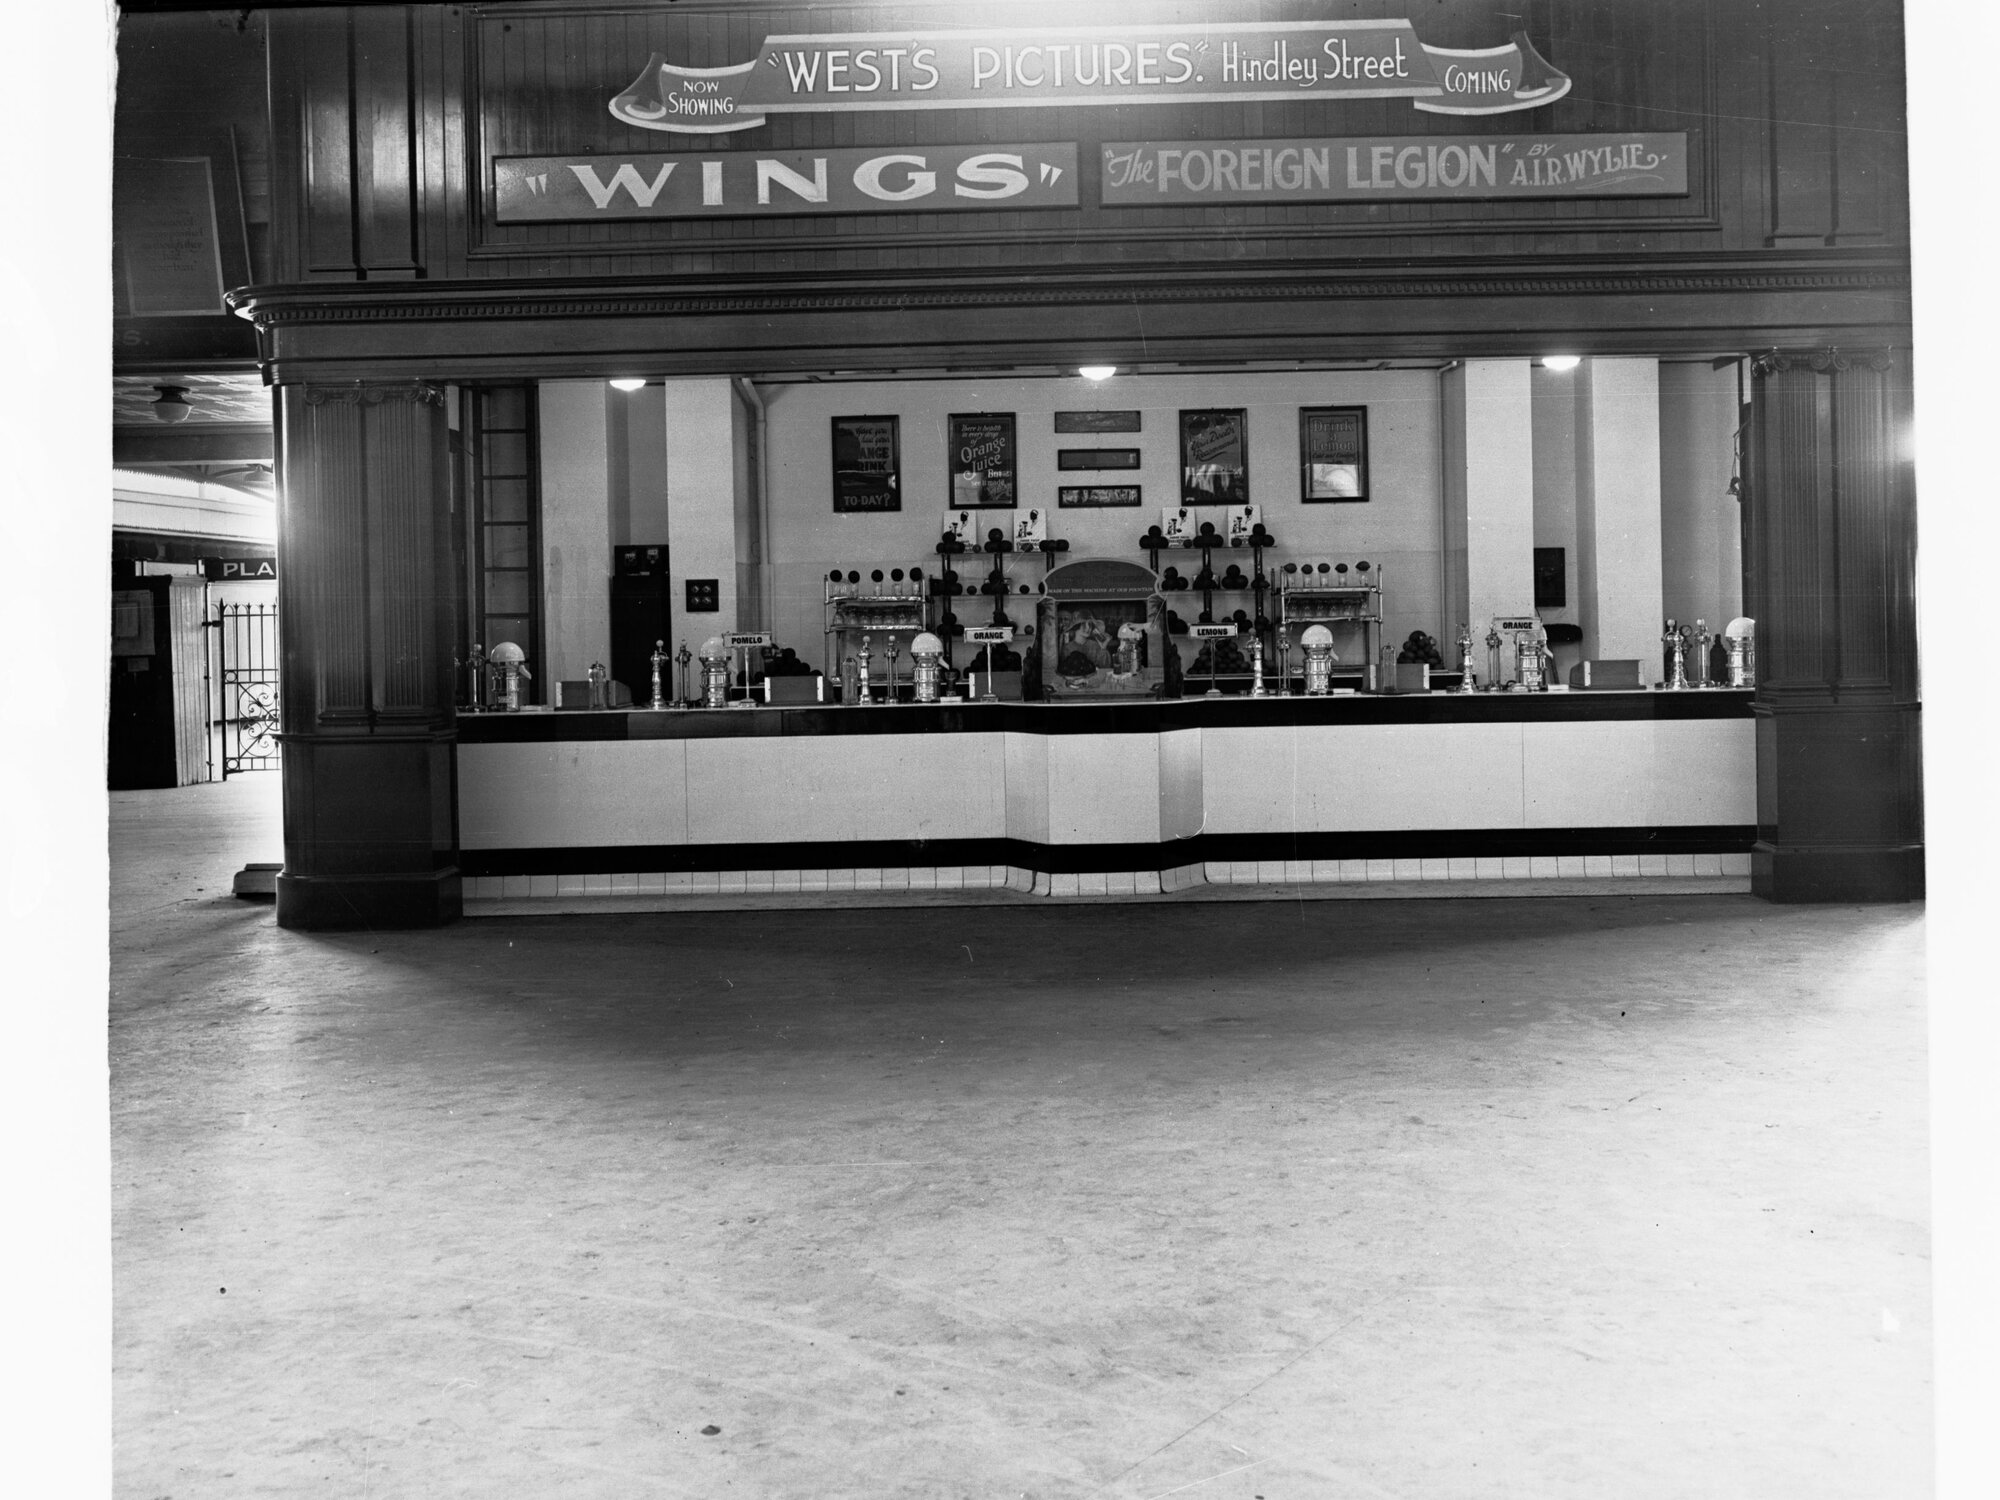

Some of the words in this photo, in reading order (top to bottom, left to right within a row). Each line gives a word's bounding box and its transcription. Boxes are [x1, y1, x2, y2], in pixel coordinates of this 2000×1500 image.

[1222, 40, 1318, 87] Hindley
[1323, 37, 1409, 79] Street
[1444, 65, 1511, 93] COMING
[683, 80, 720, 94] NOW
[668, 91, 734, 116] SHOWING
[1527, 144, 1556, 157] BY
[1157, 148, 1330, 193] FOREIGN
[1312, 418, 1354, 433] Drink
[960, 436, 1006, 464] Orange
[1312, 439, 1356, 452] Lemon
[962, 453, 1003, 481] Juice
[974, 632, 1004, 640] ORANGE
[1197, 628, 1228, 636] LEMONS
[731, 636, 762, 644] POMELO
